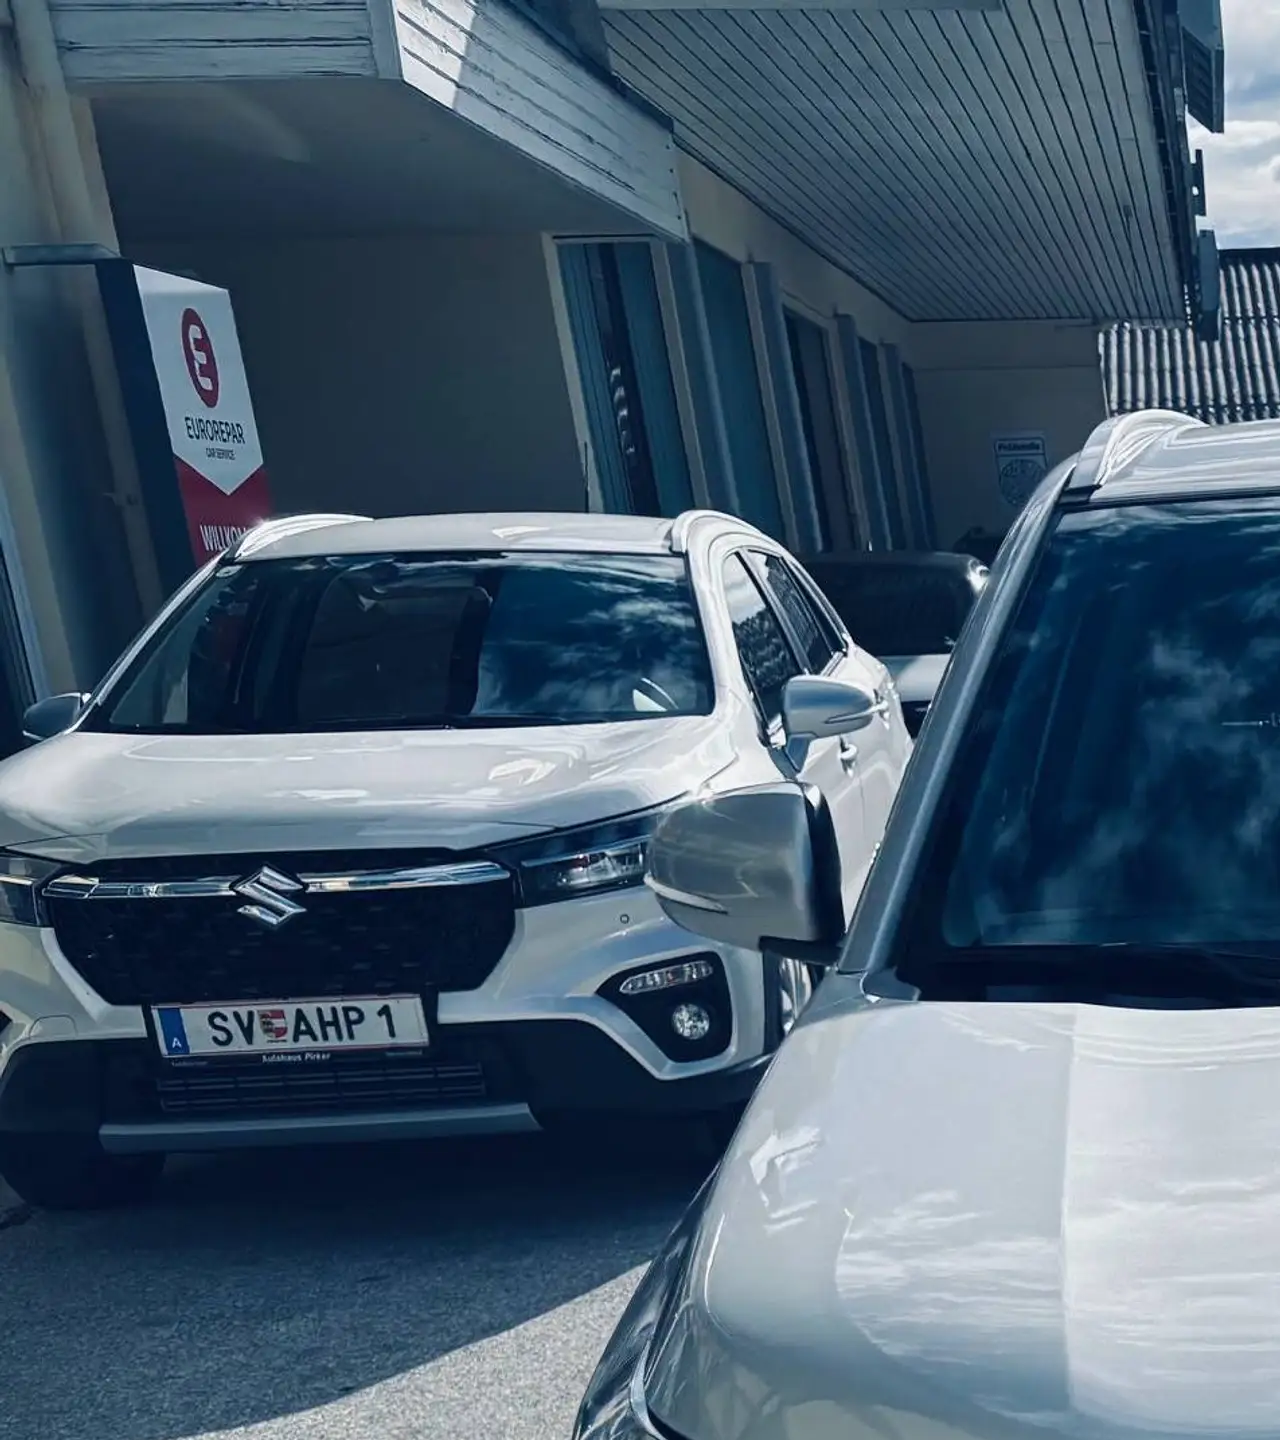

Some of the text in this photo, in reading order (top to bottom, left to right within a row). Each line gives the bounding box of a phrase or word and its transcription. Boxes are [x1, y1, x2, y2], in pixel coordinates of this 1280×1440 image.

[184, 416, 246, 444] EUROREPAR
[171, 1003, 396, 1049] A SV AHP 1
